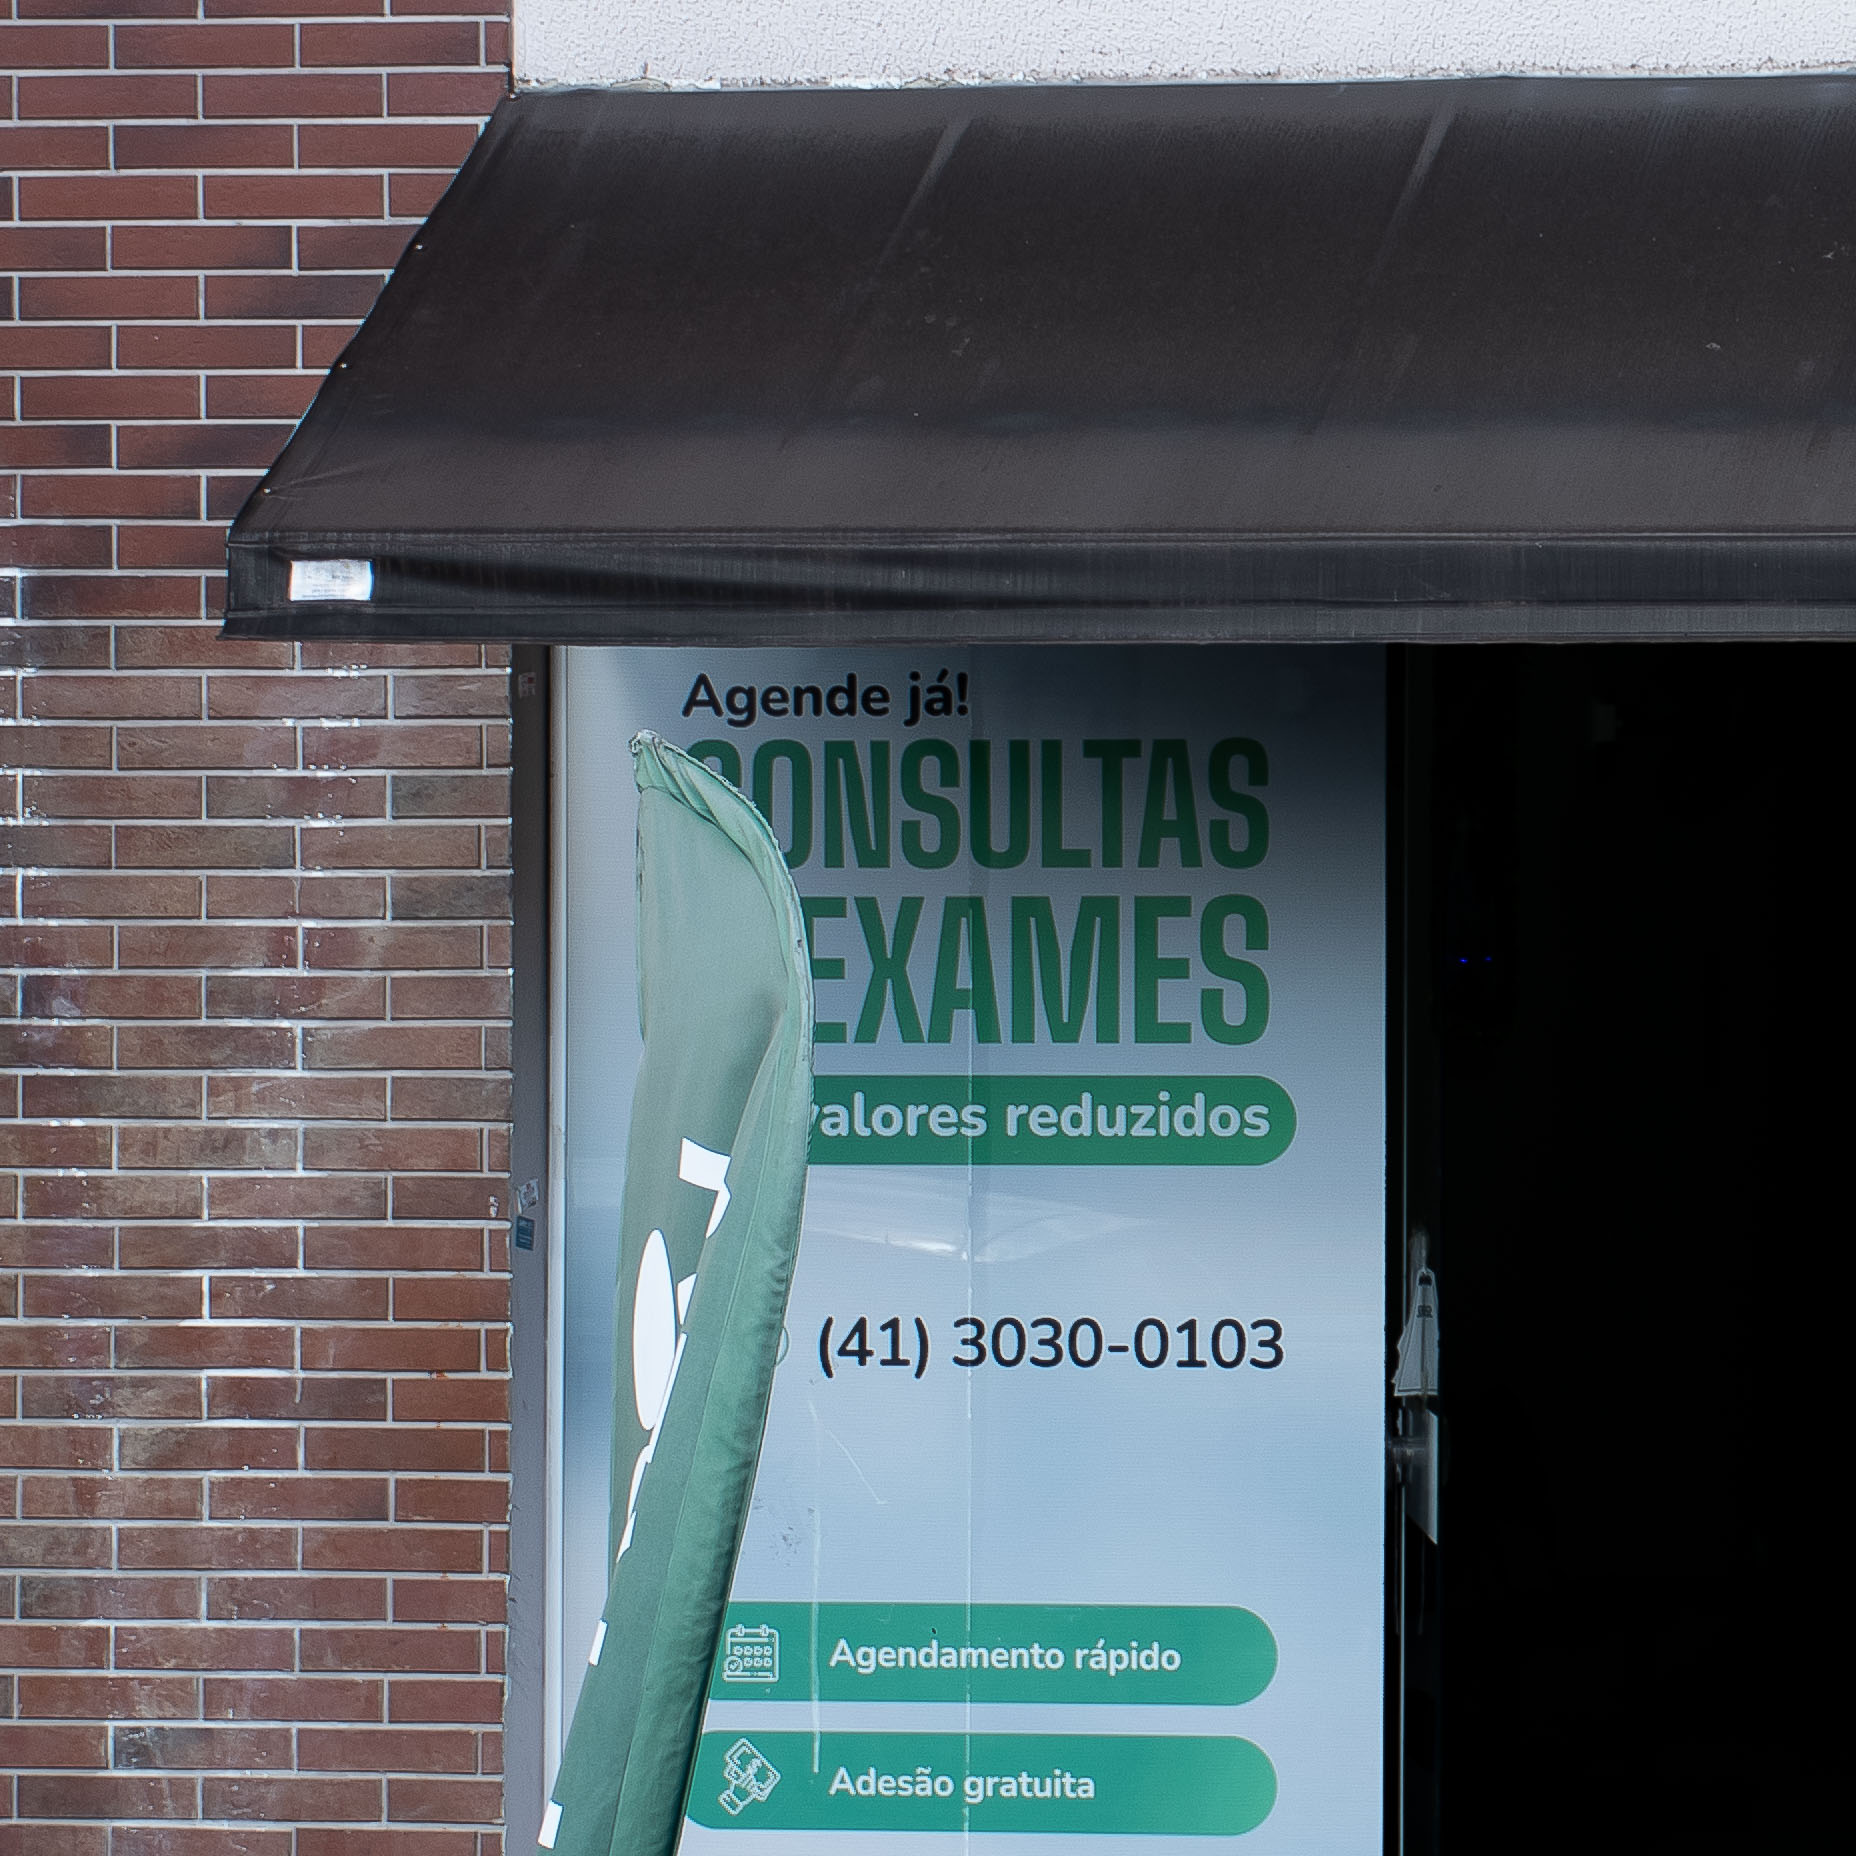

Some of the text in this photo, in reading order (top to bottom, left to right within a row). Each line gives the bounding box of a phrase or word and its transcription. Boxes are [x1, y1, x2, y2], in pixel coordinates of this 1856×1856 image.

[682, 669, 969, 727] Agende já!
[802, 893, 1271, 1045] EXAMES
[1006, 1091, 1270, 1139] reduzidos
[819, 1316, 1285, 1376] (41) 3030-0103
[830, 1638, 1181, 1676] Agendamento rápido
[829, 1765, 1096, 1804] Adesão gratuita
